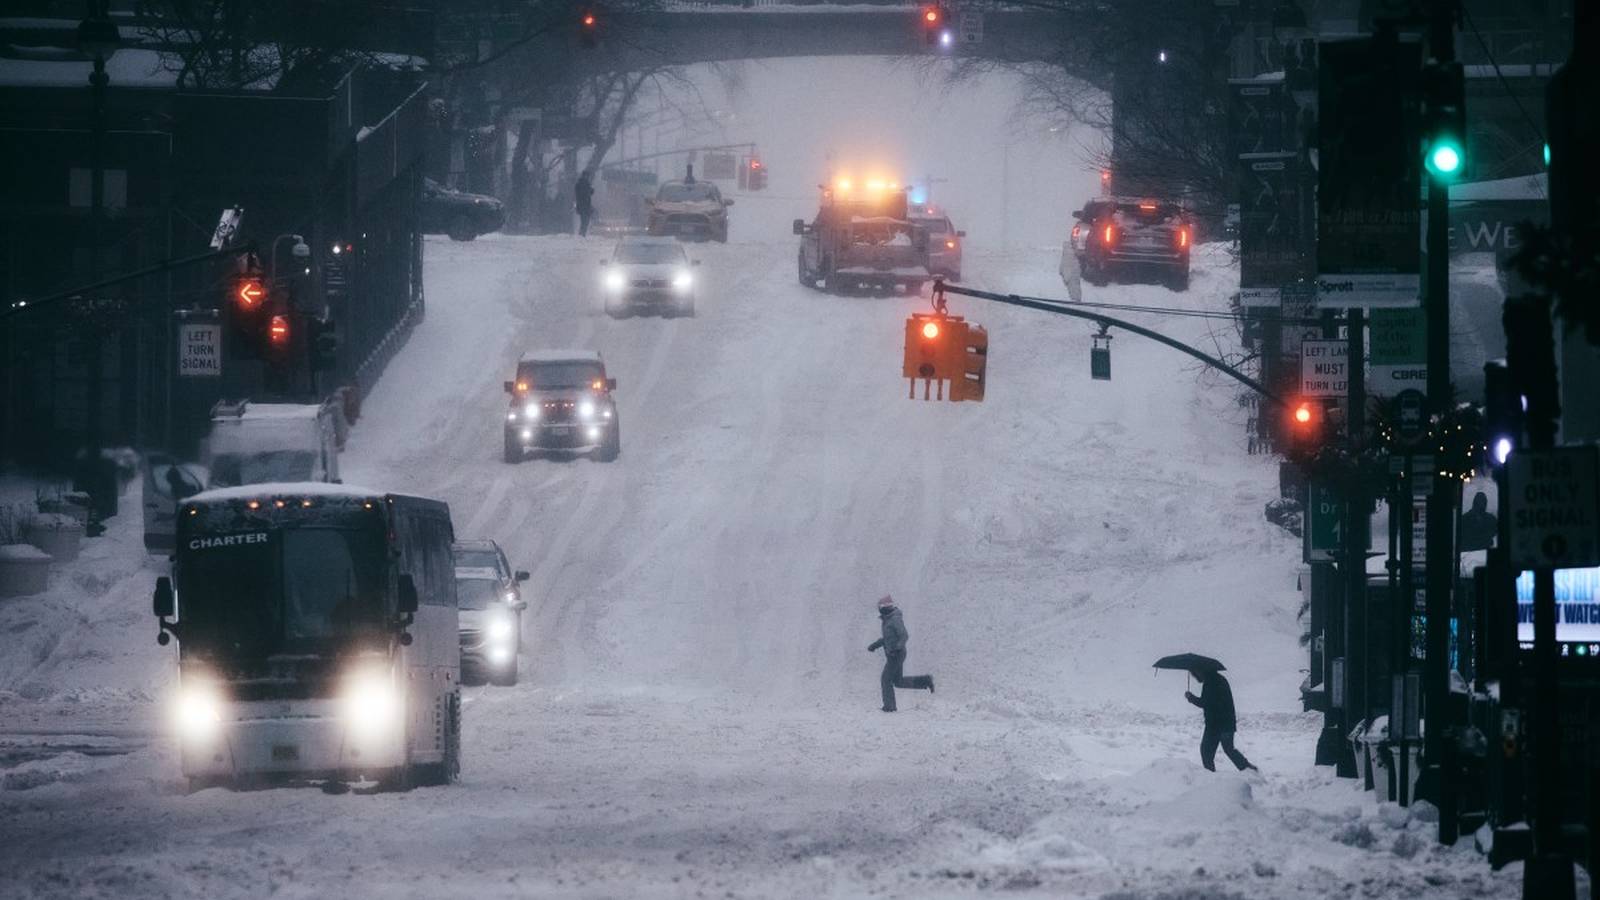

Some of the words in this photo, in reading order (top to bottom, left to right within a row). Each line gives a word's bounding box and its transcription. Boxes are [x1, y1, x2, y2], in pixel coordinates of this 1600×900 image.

[1463, 220, 1519, 249] WE
[1320, 281, 1353, 294] Sprott
[188, 331, 212, 341] LEFT
[188, 345, 214, 355] TURN
[1306, 347, 1327, 356] LEFT
[1331, 347, 1348, 356] LAN
[182, 358, 217, 369] SIGNAL
[1315, 363, 1344, 375] MUST
[1392, 370, 1427, 380] CBRE
[1305, 381, 1329, 390] TURN
[1333, 381, 1348, 391] LEF
[1531, 457, 1572, 479] BUS
[1525, 483, 1580, 505] ONLY
[1516, 508, 1592, 529] SIGNAL
[190, 532, 267, 549] CHARTER
[1564, 603, 1600, 624] WATC
